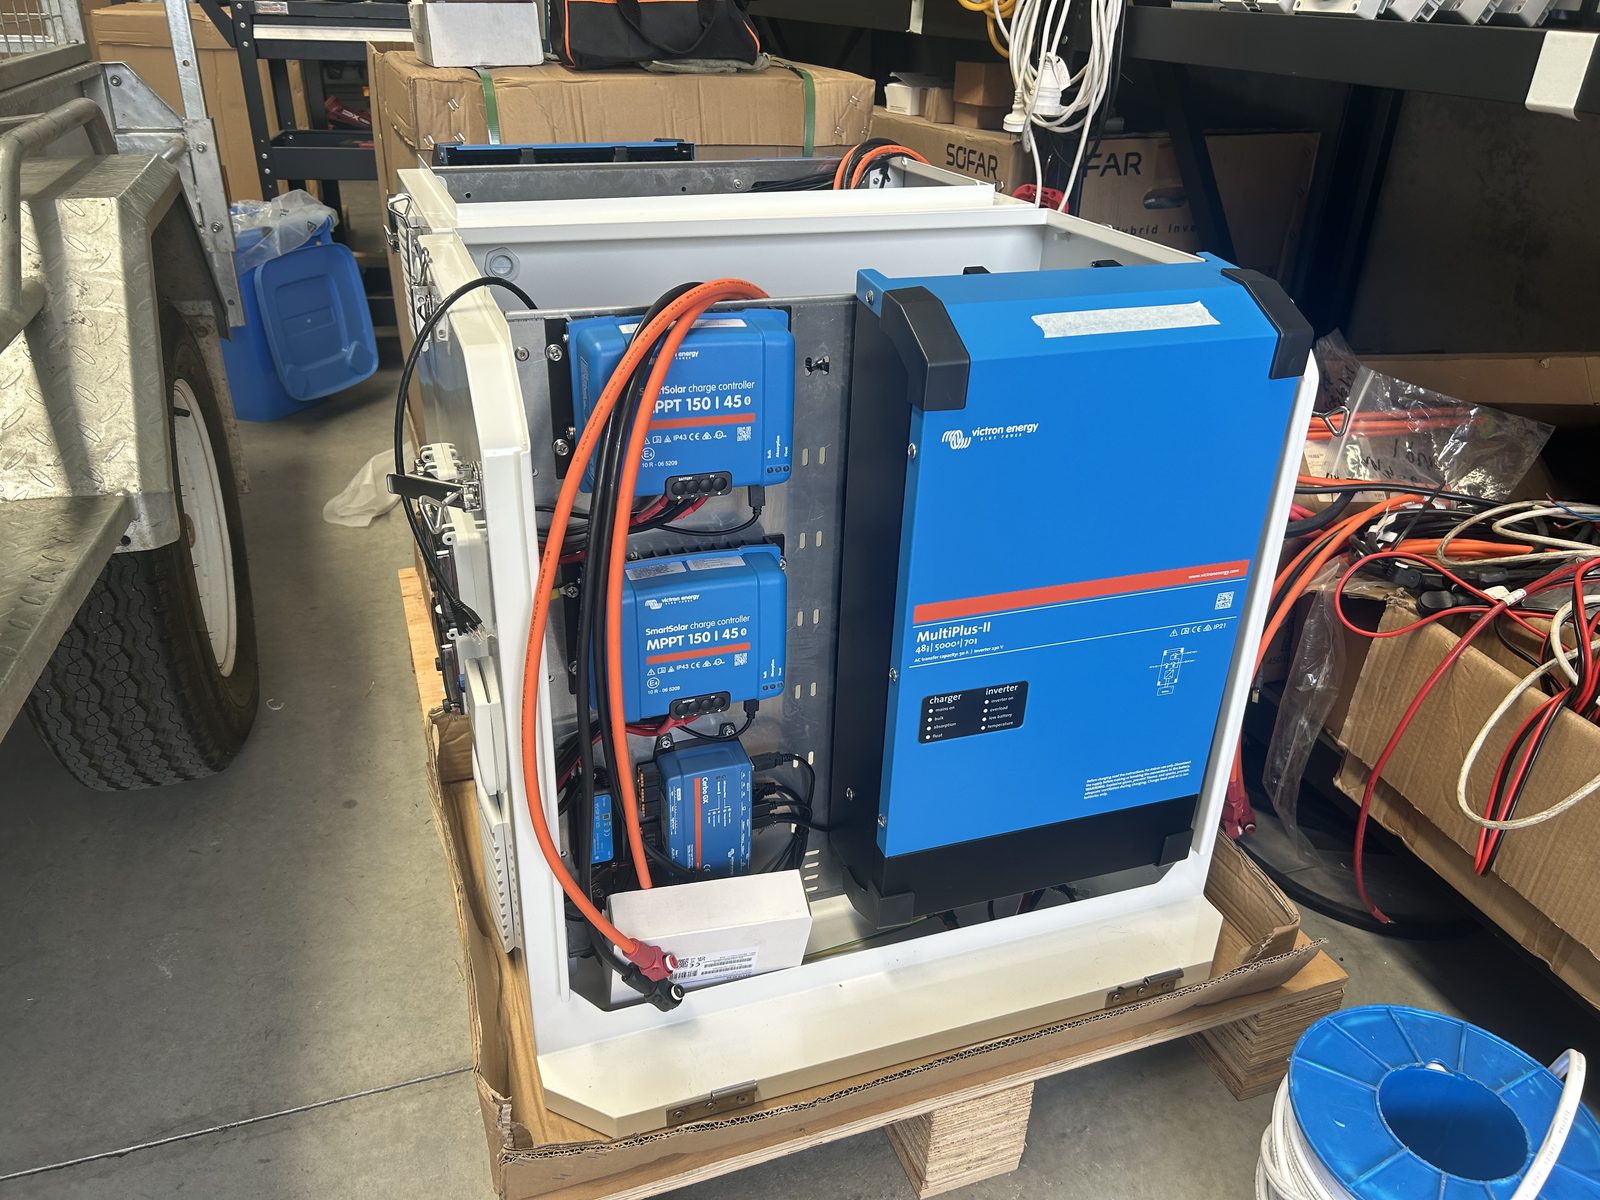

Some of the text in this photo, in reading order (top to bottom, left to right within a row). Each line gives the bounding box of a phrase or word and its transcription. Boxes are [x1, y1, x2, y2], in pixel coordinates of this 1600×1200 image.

[946, 143, 998, 180] SOFAR
[1084, 151, 1142, 177] FAR
[688, 383, 716, 394] charge
[718, 380, 756, 391] controller
[653, 399, 682, 414] PPT
[686, 396, 712, 412] 150
[724, 394, 742, 408] 45
[972, 422, 1039, 437] victron energy
[662, 596, 680, 604] victron
[646, 615, 750, 636] SmartSolar charge controller
[916, 622, 991, 643] MultiPlus-II
[646, 635, 684, 651] MPPT
[688, 632, 711, 645] 150
[722, 627, 740, 640] 45
[986, 685, 1018, 695] inverter
[929, 694, 962, 704] charger
[702, 795, 709, 804] GX
